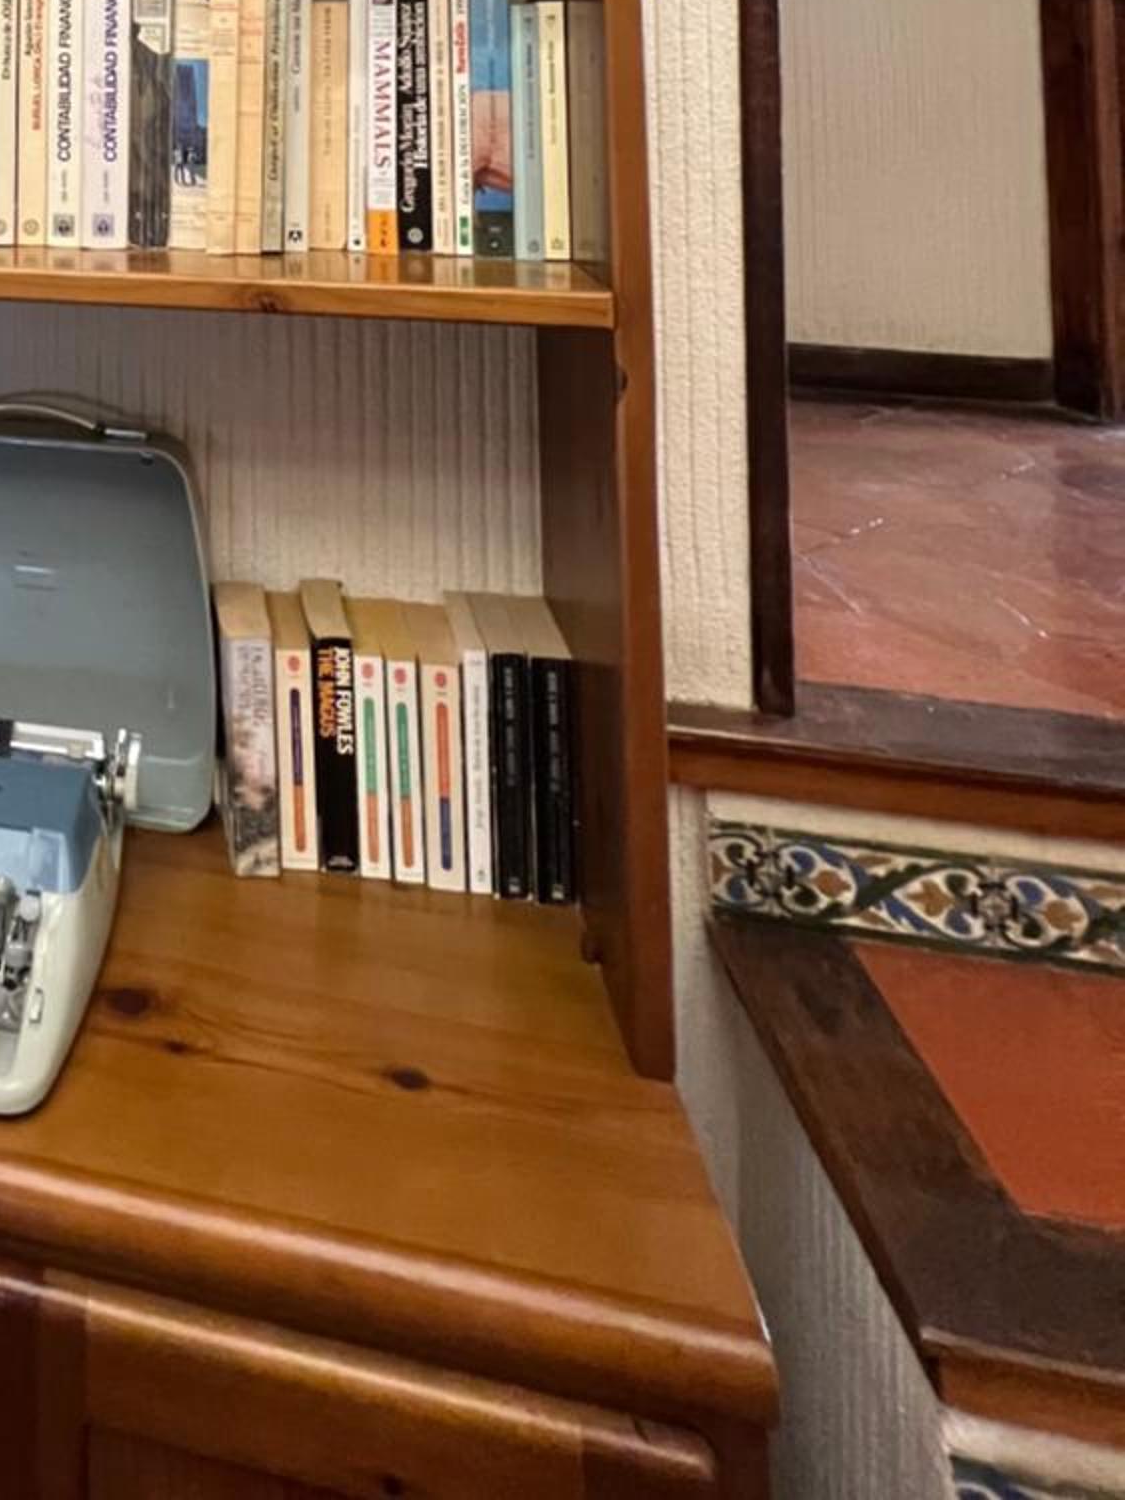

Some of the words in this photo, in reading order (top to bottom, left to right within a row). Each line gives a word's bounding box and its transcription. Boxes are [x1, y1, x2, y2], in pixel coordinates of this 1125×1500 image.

[412, 1, 426, 66] ambición
[56, 52, 73, 163] CONTABILIDAD
[103, 52, 119, 163] CONTABILIDAD
[373, 41, 392, 169] MAMMALS
[413, 96, 427, 113] de
[414, 67, 426, 95] una
[413, 114, 428, 169] Historia
[318, 648, 334, 677] THE
[334, 646, 352, 687] JOHN
[320, 680, 336, 738] MAGUS
[336, 689, 355, 755] FOWLES
